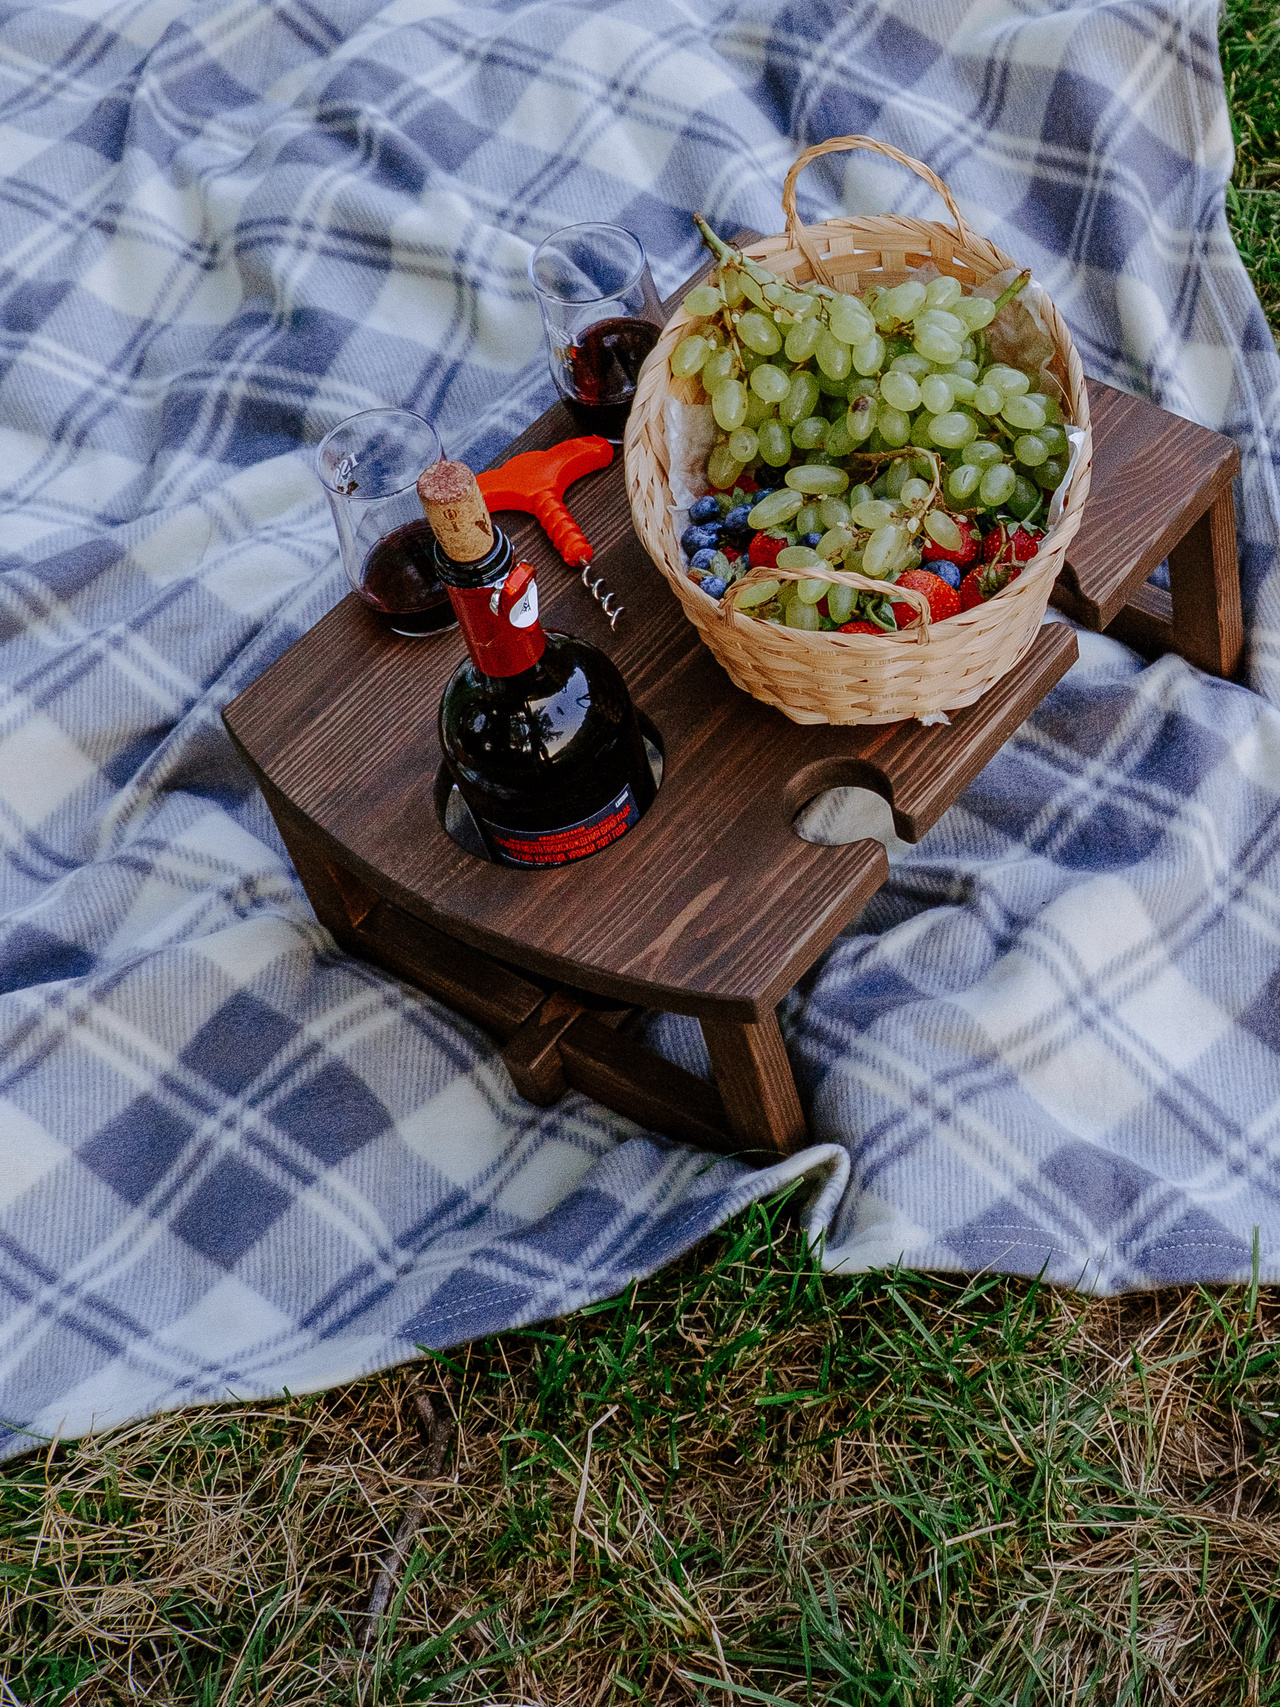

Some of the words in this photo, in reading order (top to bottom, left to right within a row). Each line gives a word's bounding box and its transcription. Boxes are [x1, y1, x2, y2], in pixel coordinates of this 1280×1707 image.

[521, 844, 543, 854] МЕСТО
[543, 829, 601, 854] ПРОИСХОЖДЕНИЯ
[600, 804, 632, 836] ВИНОГРАДА
[596, 834, 612, 849] 2021
[612, 821, 628, 838] ГОДА
